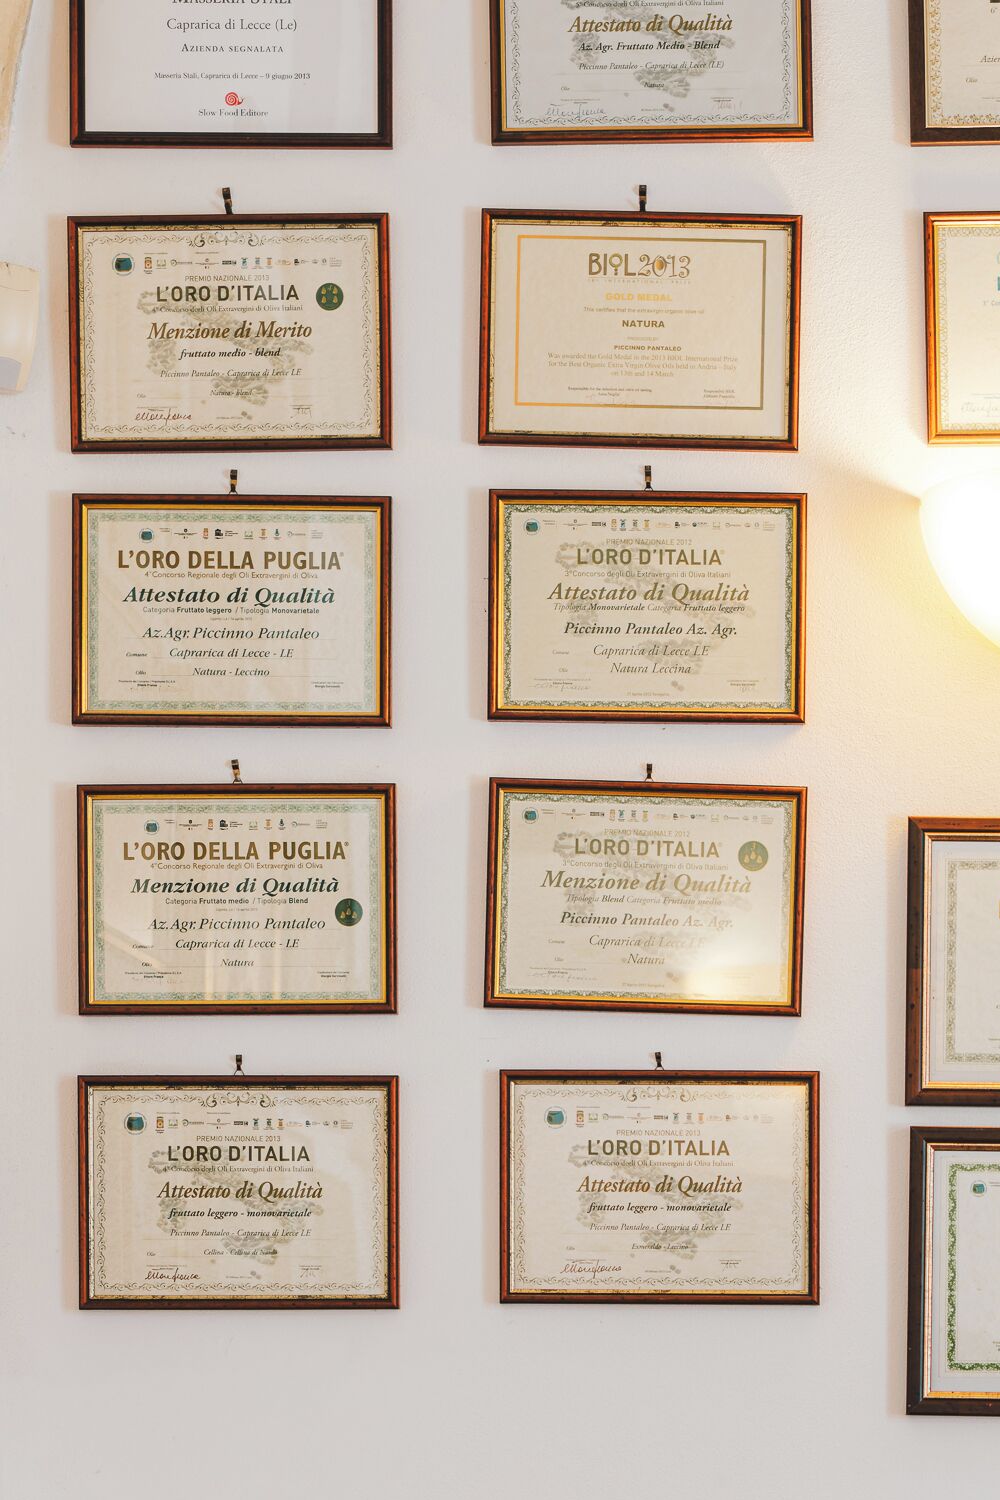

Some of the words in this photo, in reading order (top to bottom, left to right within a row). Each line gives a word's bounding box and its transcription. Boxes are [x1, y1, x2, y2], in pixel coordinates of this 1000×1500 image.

[167, 18, 221, 33] Caprarica
[224, 18, 236, 30] di
[240, 18, 271, 30] Lecce
[275, 18, 297, 32] (Le)
[568, 15, 642, 33] Attestato
[646, 14, 664, 32] di
[668, 14, 733, 36] Qualità
[595, 41, 614, 53] Agr.
[616, 41, 654, 51] Fruttato
[658, 40, 685, 50] Medio
[694, 40, 720, 50] Blend
[156, 286, 211, 302] L'ORO
[217, 285, 299, 301] D'ITALIA
[147, 322, 230, 340] Menzione
[234, 320, 251, 338] di
[255, 321, 312, 338] Merito
[622, 319, 665, 328] NATURA
[178, 348, 216, 360] fruttato
[218, 348, 246, 358] medio
[255, 348, 281, 357] blend
[119, 551, 180, 569] L'ORO
[188, 551, 254, 569] DELLA
[264, 551, 341, 570] PUGLIA
[577, 549, 632, 564] L'ORO
[639, 549, 722, 565] D'ITALIA
[123, 587, 220, 603] Attestato
[227, 587, 248, 603] di
[254, 587, 335, 607] Qualità
[547, 583, 638, 601] Attestato
[644, 582, 664, 601] di
[671, 583, 750, 604] Qualità
[205, 607, 232, 616] leggero
[240, 607, 270, 616] Tipologia
[271, 607, 320, 615] Monovarietale
[564, 622, 621, 635] Piccinno
[625, 623, 683, 635] Pantaleo
[686, 623, 707, 635] Az.
[711, 624, 737, 639] Agr.
[124, 842, 185, 861] L'ORO
[193, 842, 259, 860] DELLA
[269, 842, 346, 860] PUGLIA
[575, 838, 630, 856] L'ORO
[637, 840, 720, 858] D'ITALIA
[131, 878, 229, 894] Menzione
[236, 877, 256, 893] di
[262, 878, 339, 897] Qualità
[541, 870, 640, 890] Menzione
[646, 872, 667, 891] di
[673, 874, 752, 894] Qualità
[168, 1146, 222, 1162] L'ORO
[228, 1146, 310, 1162] D'ITALIA
[588, 1140, 642, 1156] L'ORO
[648, 1140, 730, 1156] D'ITALIA
[157, 1182, 232, 1199] Attestato
[235, 1180, 253, 1198] di
[257, 1181, 323, 1203] Qualità
[576, 1176, 651, 1193] Attestato
[655, 1175, 673, 1193] di
[677, 1175, 743, 1196] Qualità
